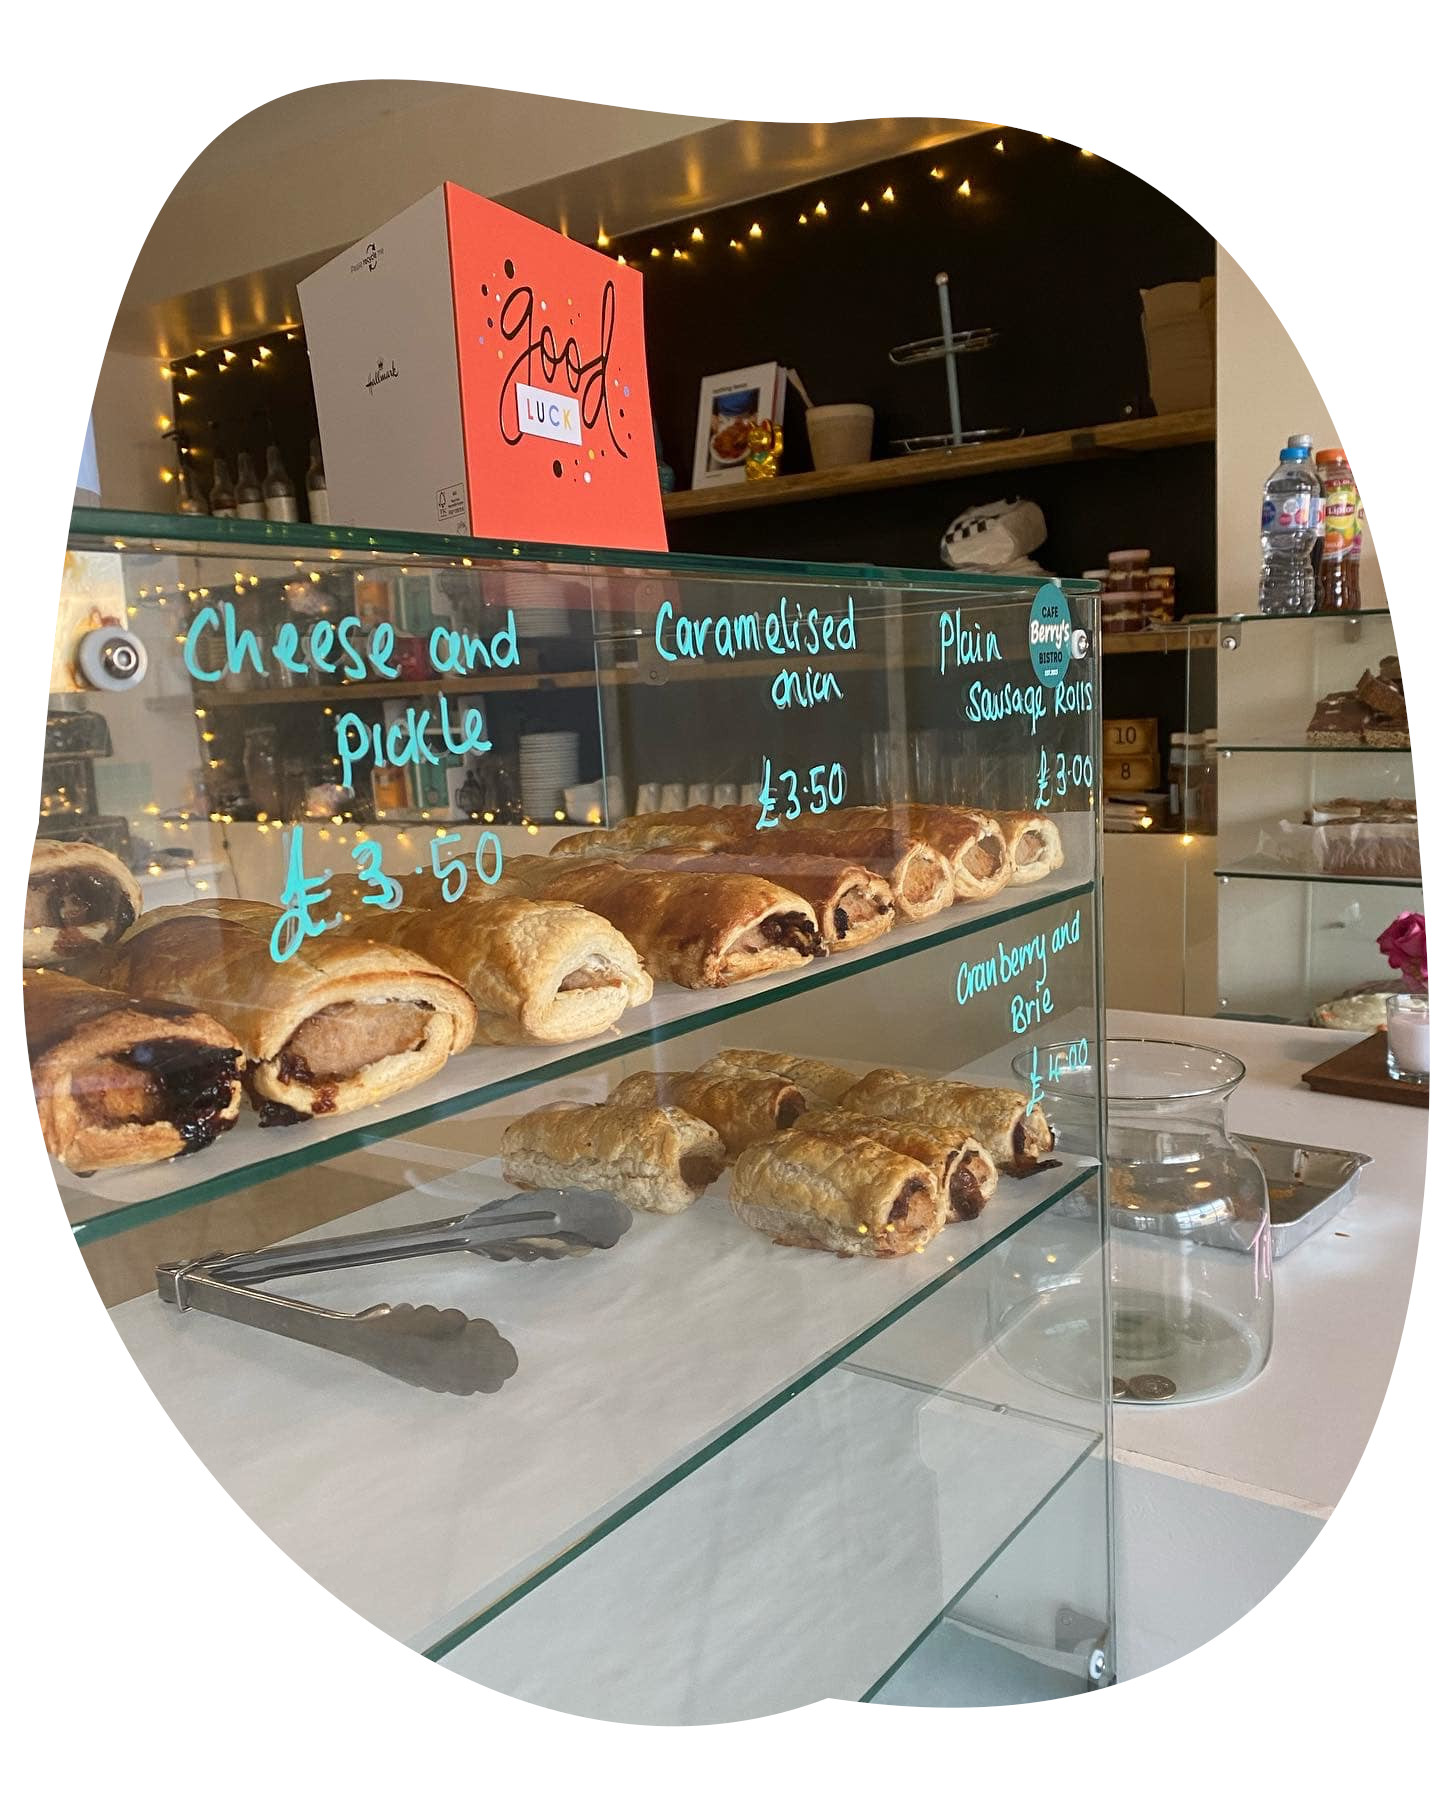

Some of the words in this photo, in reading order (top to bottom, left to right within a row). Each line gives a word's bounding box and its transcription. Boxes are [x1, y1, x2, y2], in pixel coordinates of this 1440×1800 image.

[500, 280, 628, 459] good
[526, 397, 572, 431] LUCK
[655, 596, 857, 662] Caramelised
[1030, 619, 1070, 649] Berry's
[1041, 606, 1059, 618] CAFE
[184, 602, 399, 682] Cheese
[428, 610, 522, 676] and
[939, 606, 1003, 676] Plain
[1039, 651, 1063, 665] BISTRO
[966, 680, 1047, 736] Sausage
[1054, 678, 1094, 717] Rolls
[1114, 726, 1137, 744] 10
[1121, 762, 1131, 780] 8
[956, 934, 1047, 1005] Cranberry
[1051, 908, 1081, 954] and
[1010, 983, 1054, 1034] Brie
